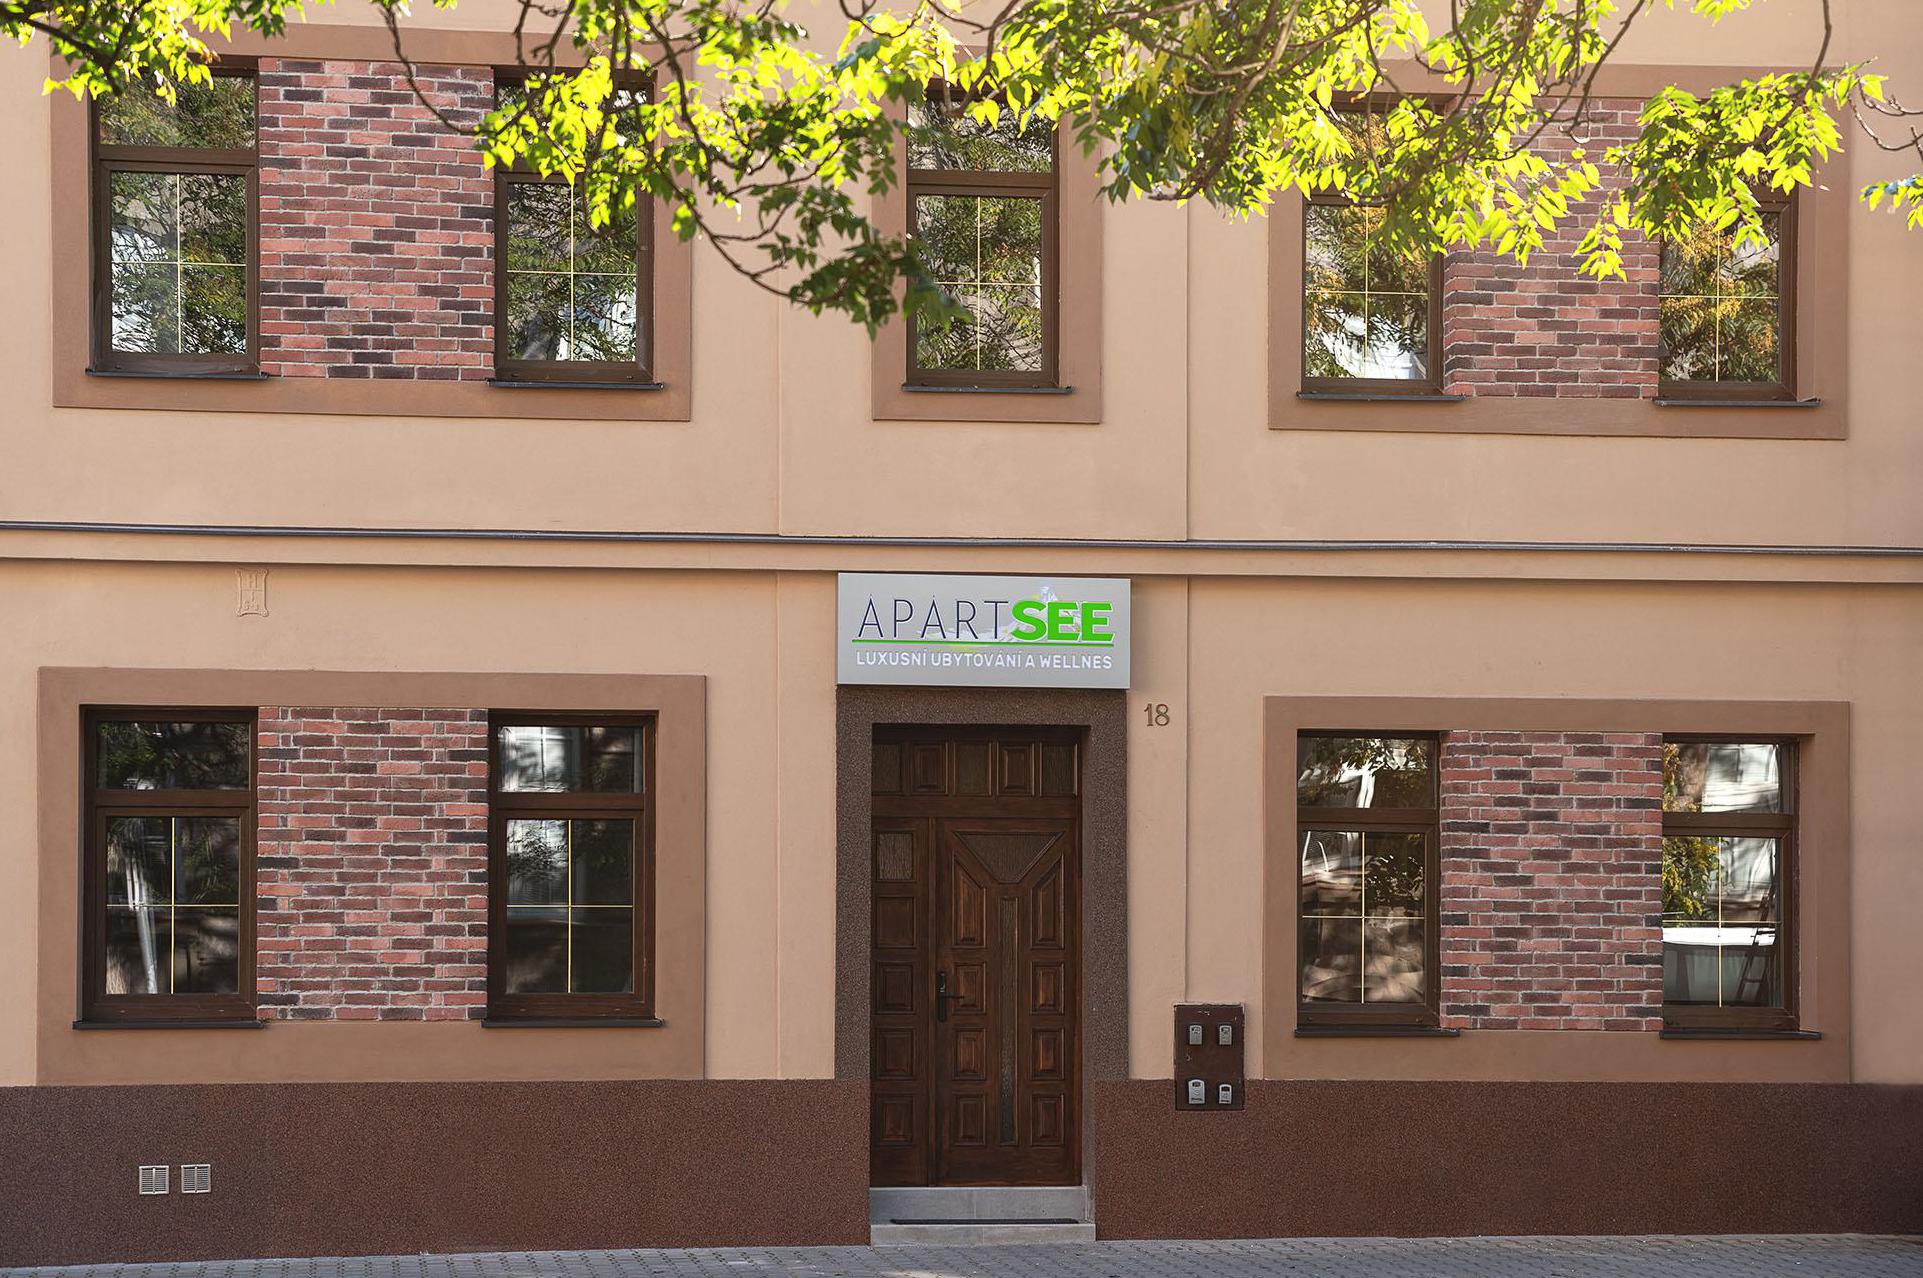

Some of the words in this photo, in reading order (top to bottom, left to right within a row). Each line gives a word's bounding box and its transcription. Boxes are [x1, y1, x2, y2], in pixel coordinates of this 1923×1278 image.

[856, 648, 927, 666] LUXUSNÍ
[931, 649, 1022, 668] UBYTOVÁNÍ
[1025, 655, 1036, 668] A
[1040, 656, 1112, 669] WELLNES
[1144, 703, 1170, 727] 18
